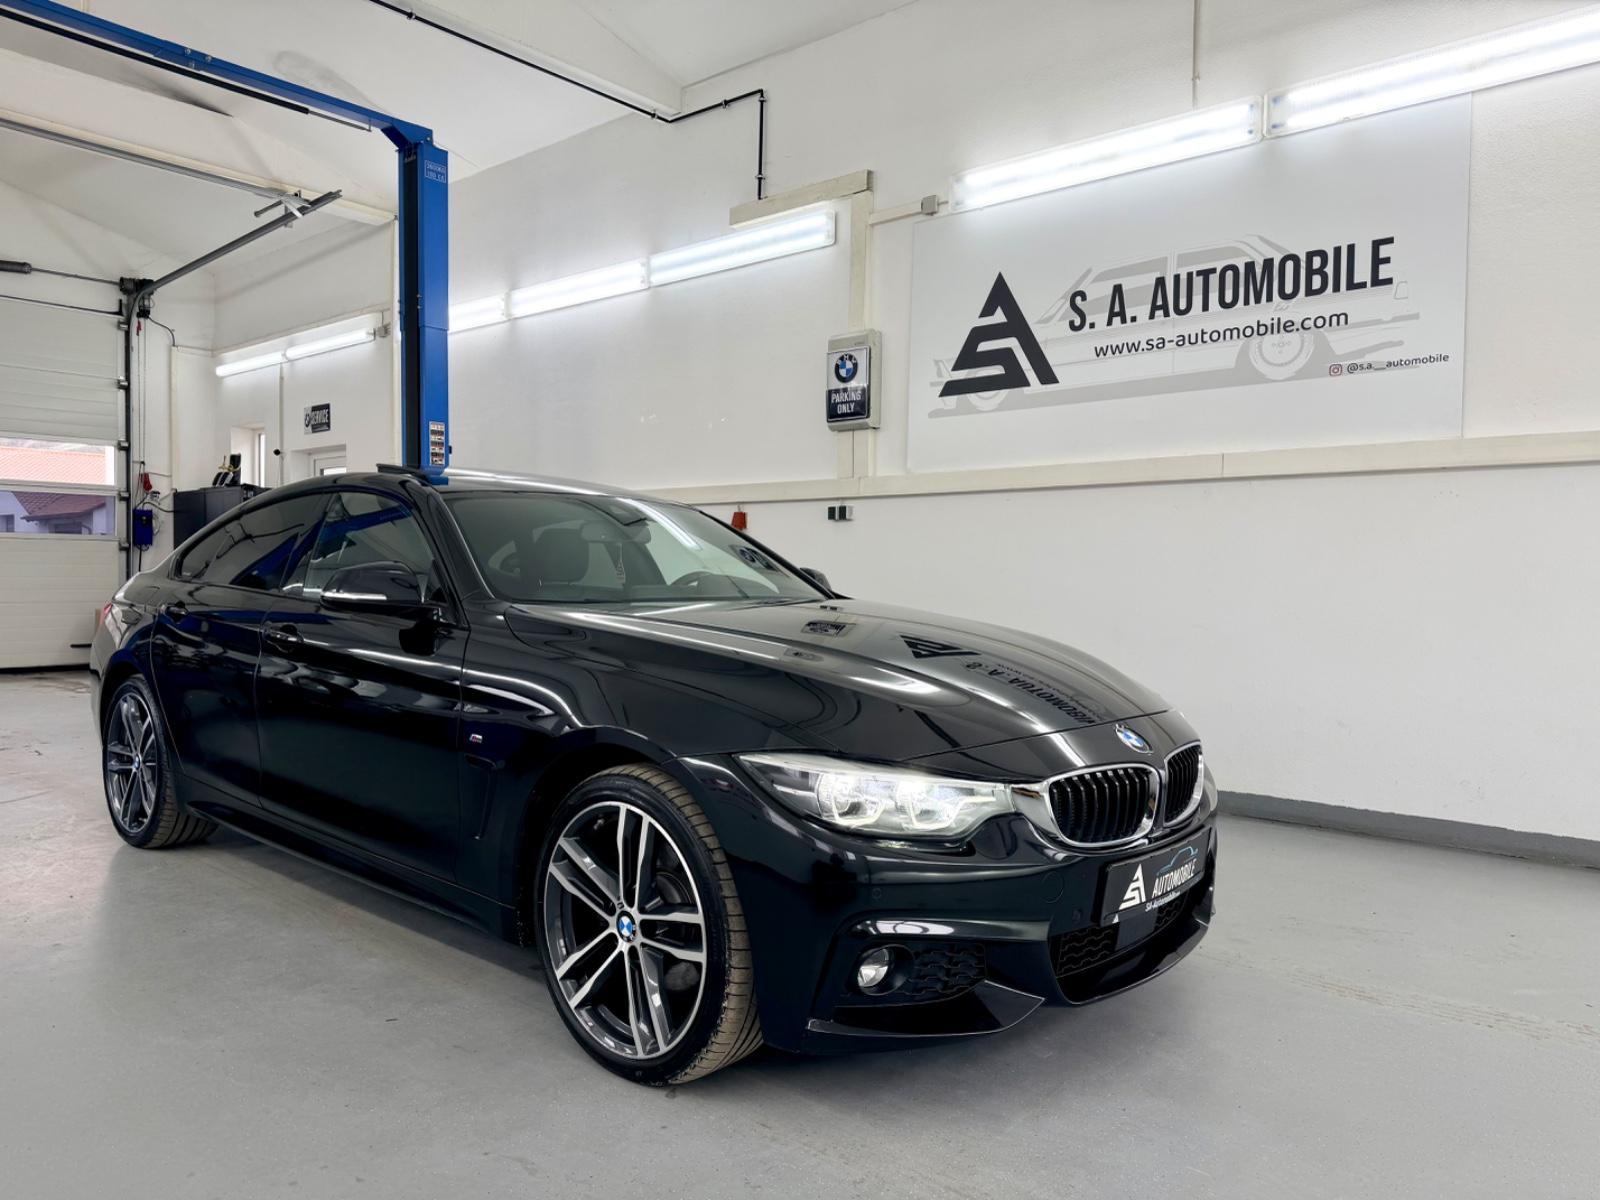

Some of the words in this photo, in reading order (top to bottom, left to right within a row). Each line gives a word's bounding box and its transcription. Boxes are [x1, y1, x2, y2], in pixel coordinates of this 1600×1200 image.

[1068, 289, 1095, 332] S.
[1106, 283, 1137, 327] A.
[1148, 236, 1395, 321] AUTOMOBILE
[1094, 312, 1349, 358] www.sa-automobile.com
[831, 391, 862, 403] PARKING
[837, 402, 855, 414] ONLY
[1151, 858, 1198, 899] AUTOMOBILE
